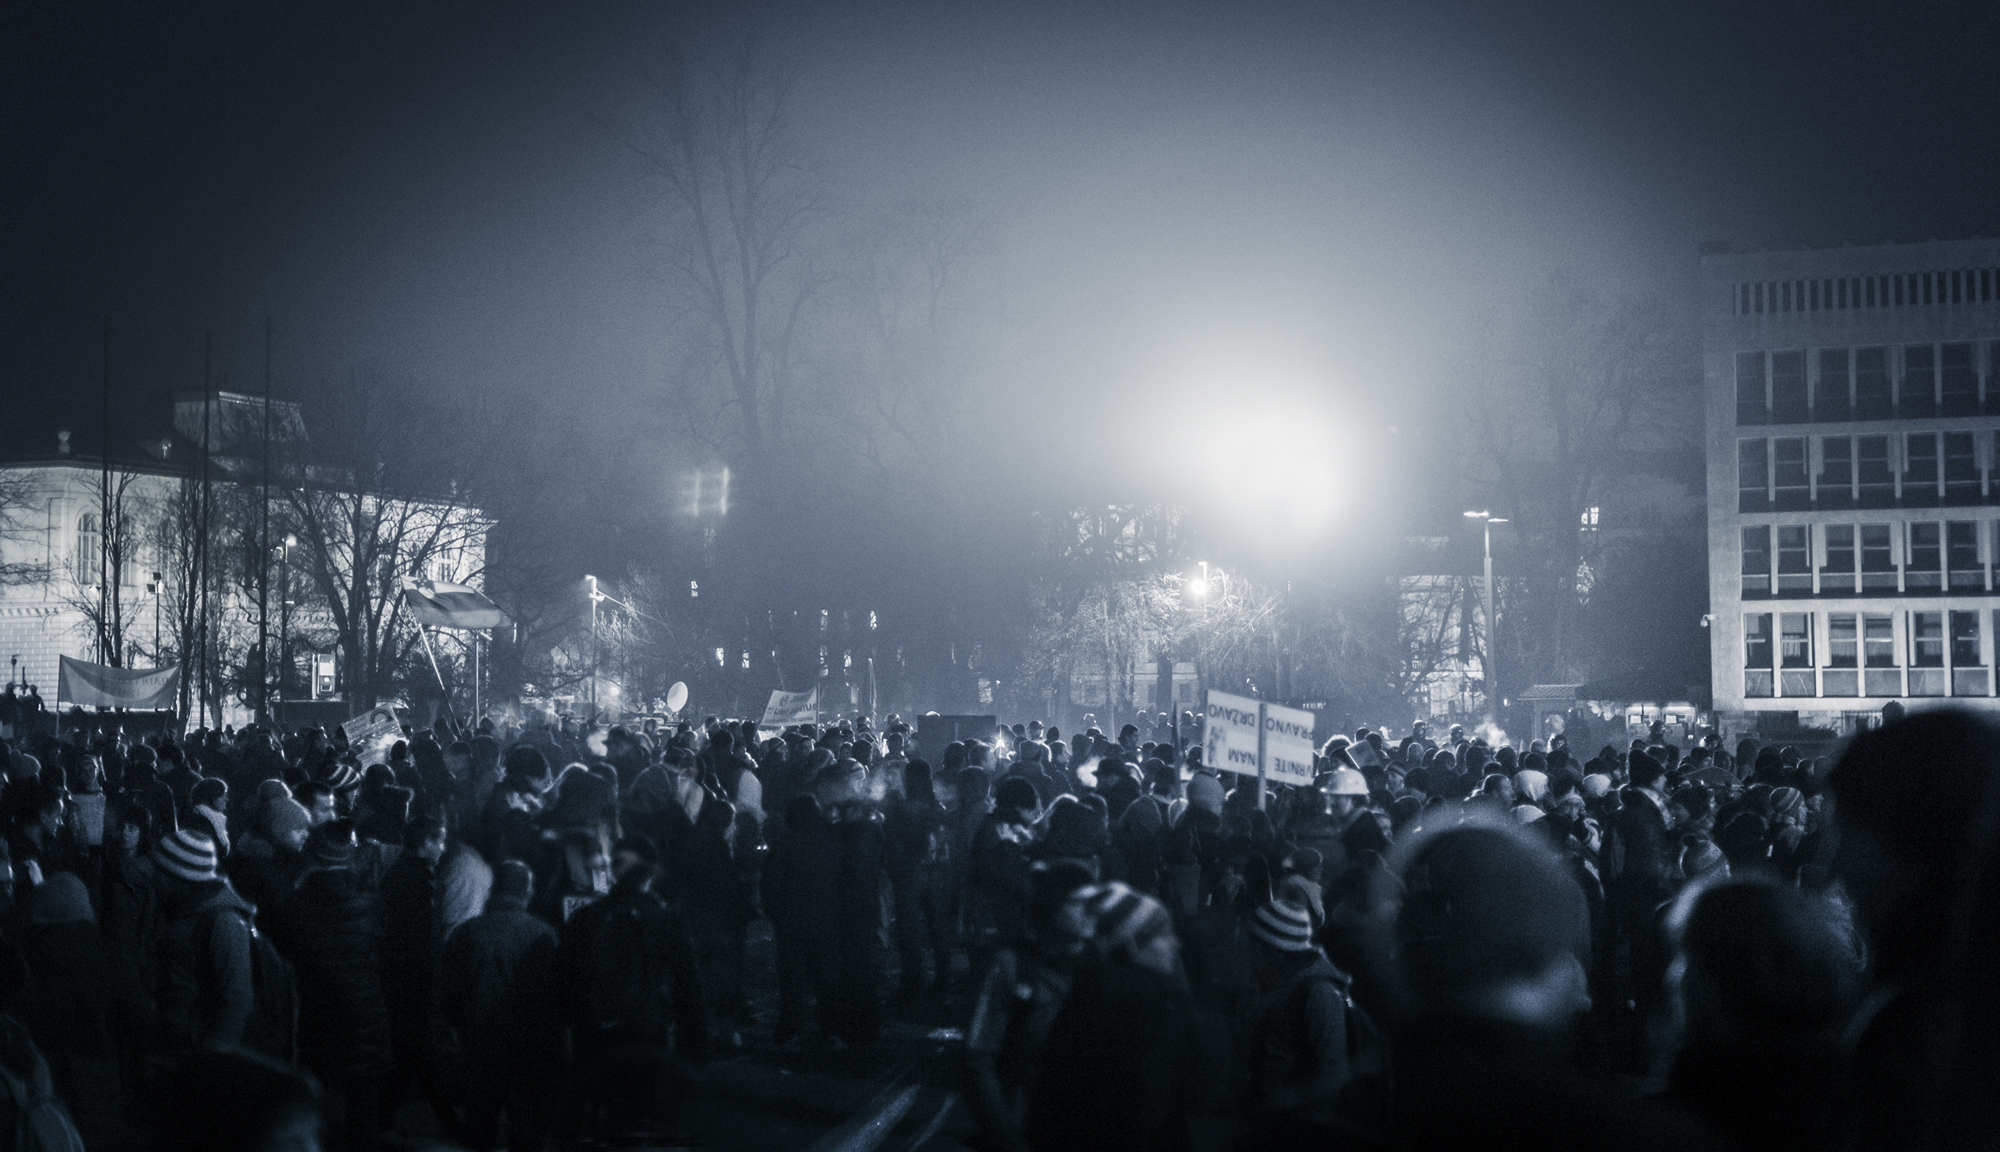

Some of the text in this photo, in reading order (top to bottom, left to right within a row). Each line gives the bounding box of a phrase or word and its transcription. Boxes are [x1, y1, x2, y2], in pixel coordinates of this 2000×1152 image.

[1208, 703, 1313, 741] PRAVNO DRŽAVO
[1228, 748, 1313, 778] VRNITE NAM
